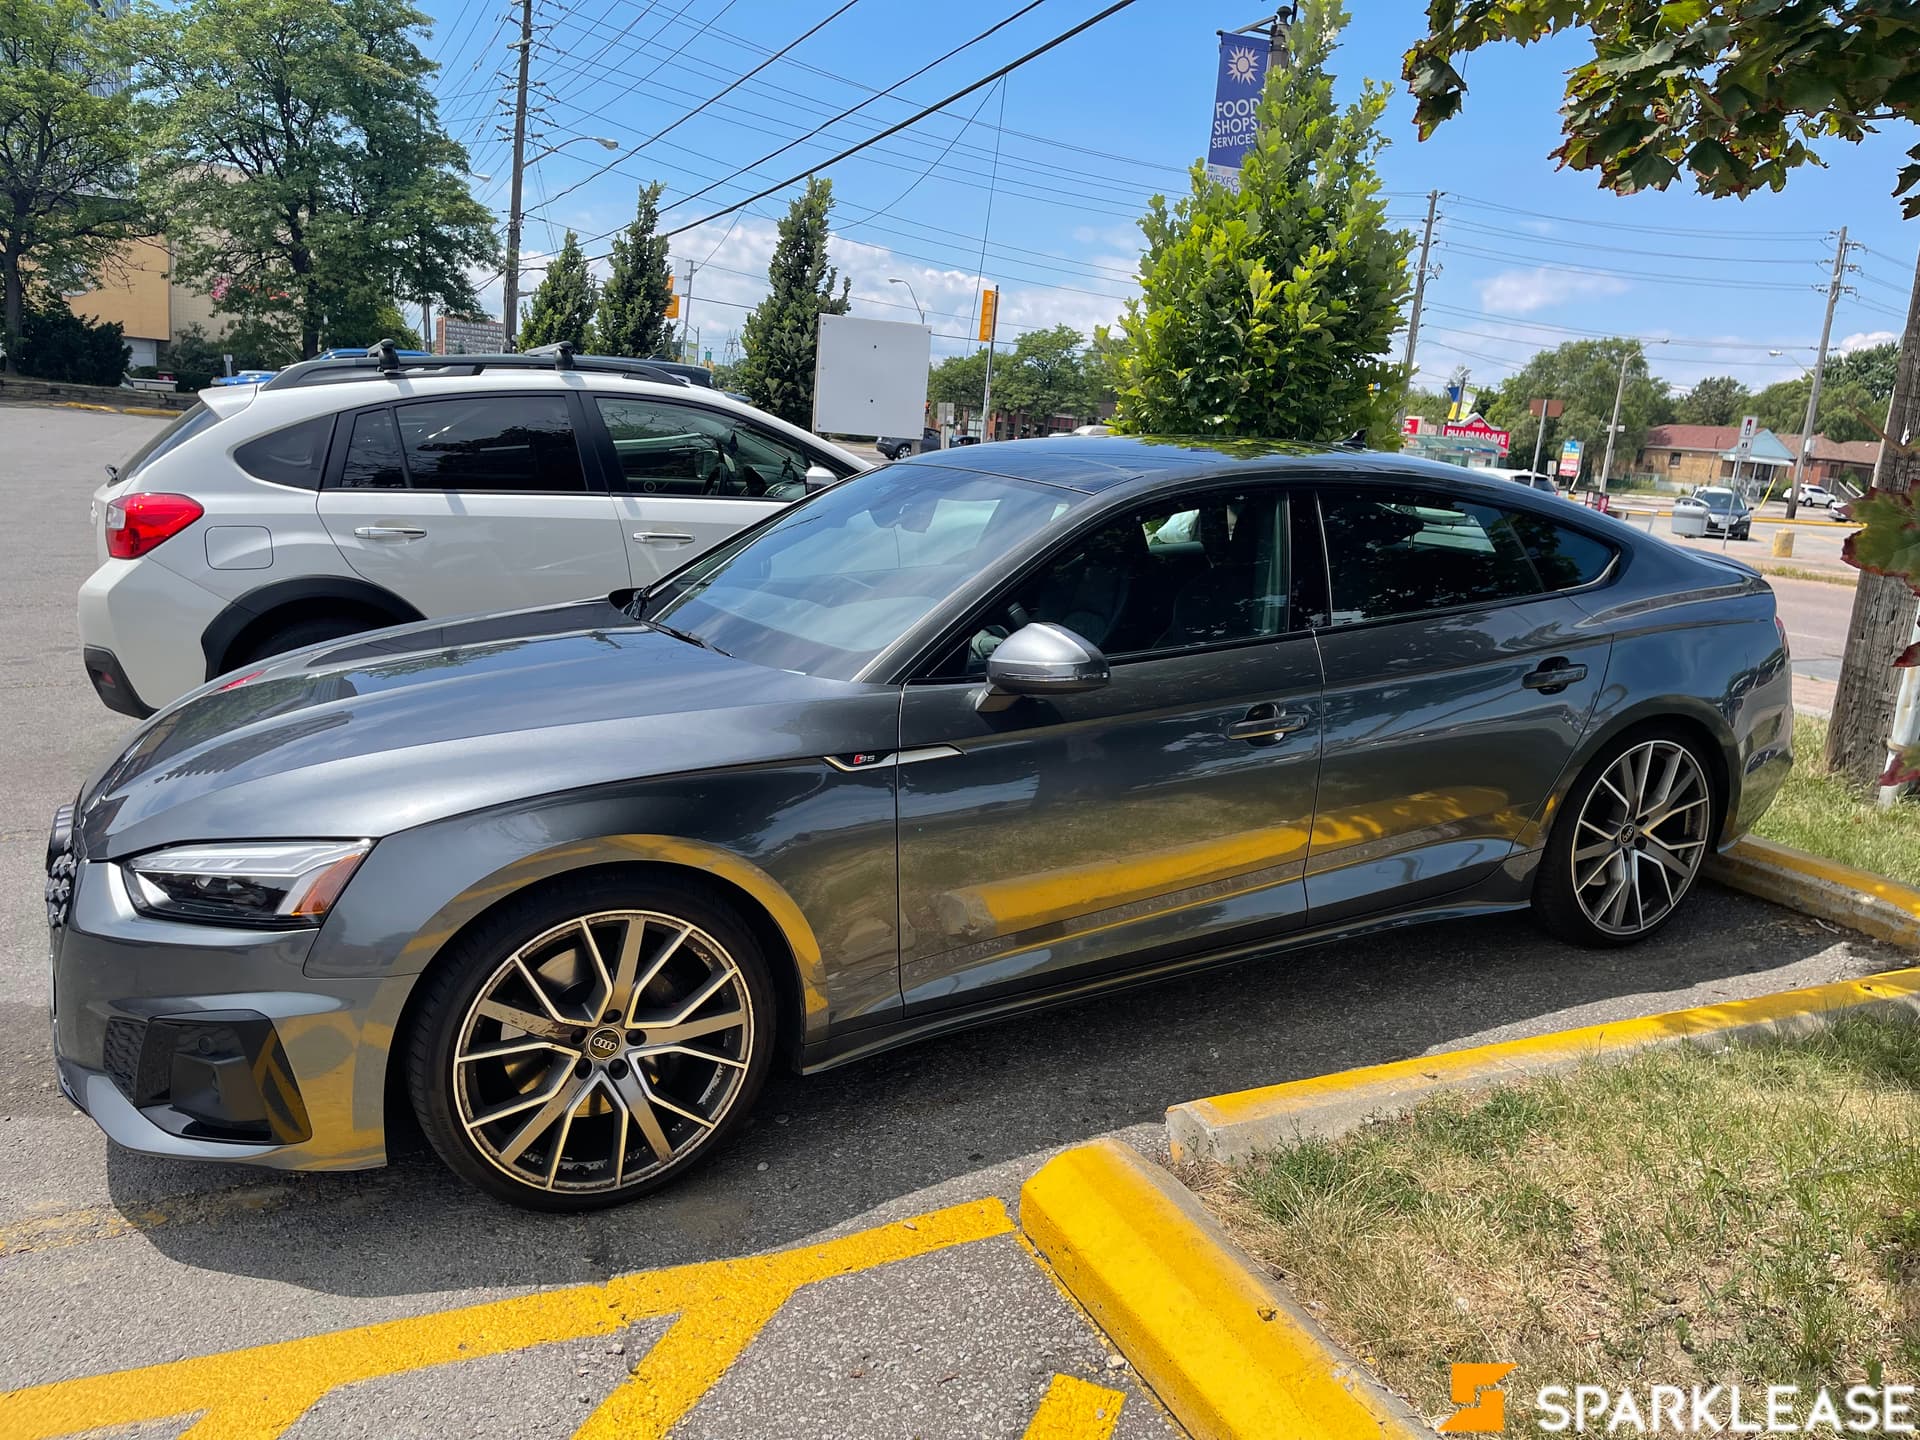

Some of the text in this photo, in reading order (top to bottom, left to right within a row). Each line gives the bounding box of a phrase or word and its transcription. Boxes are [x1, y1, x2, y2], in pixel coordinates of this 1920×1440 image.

[1216, 98, 1261, 119] FOOD
[1214, 116, 1257, 135] SHOPS
[1212, 133, 1256, 149] SERVICES
